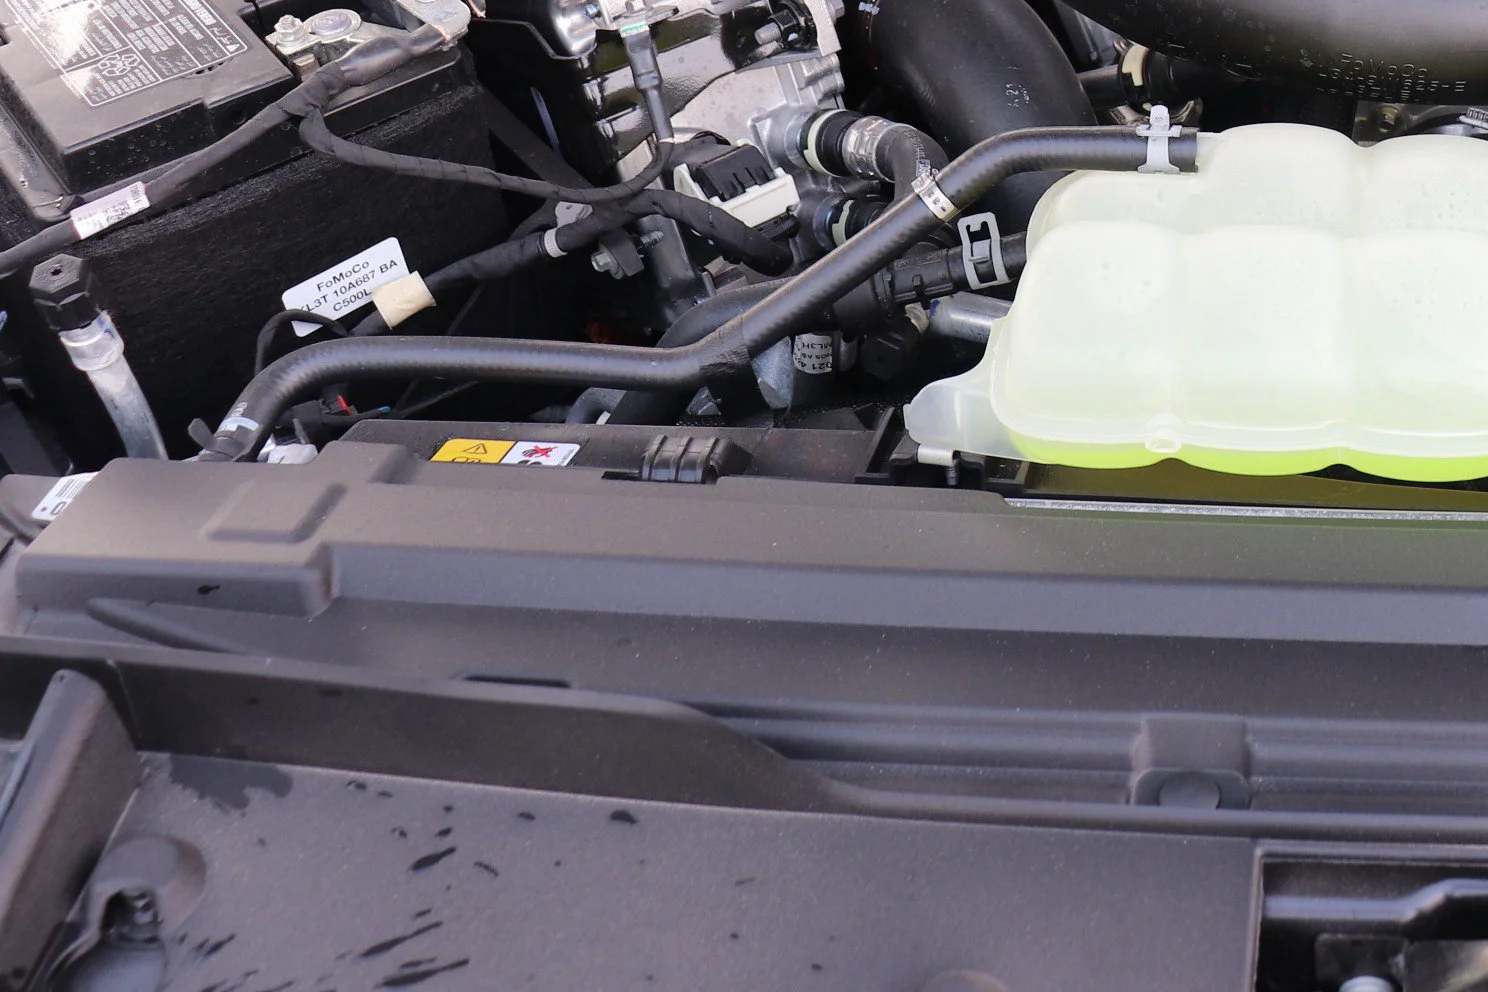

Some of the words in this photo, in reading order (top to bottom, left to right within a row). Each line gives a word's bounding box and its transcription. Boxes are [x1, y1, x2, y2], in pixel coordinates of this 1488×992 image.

[316, 261, 370, 292] FoMoCo
[333, 270, 378, 298] 10A687
[379, 259, 398, 274] BA
